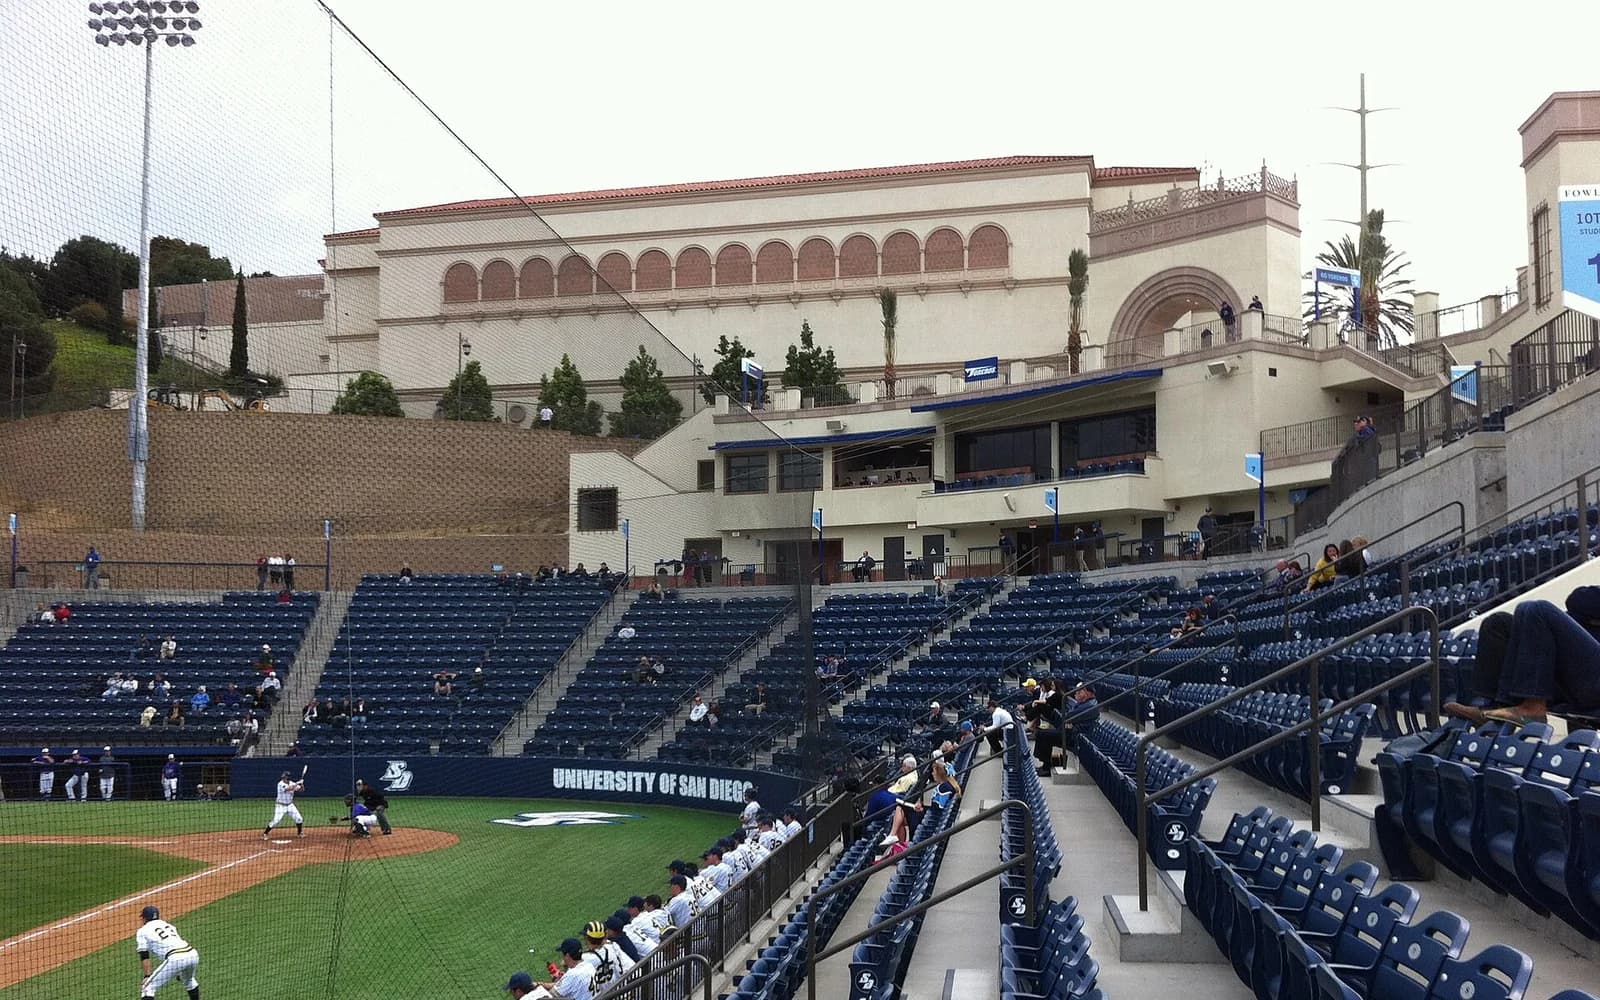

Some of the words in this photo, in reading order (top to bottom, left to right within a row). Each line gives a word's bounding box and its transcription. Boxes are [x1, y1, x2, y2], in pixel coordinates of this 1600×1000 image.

[553, 767, 657, 793] UNIVERSITY
[659, 772, 678, 795] OF
[678, 774, 707, 799] SAN
